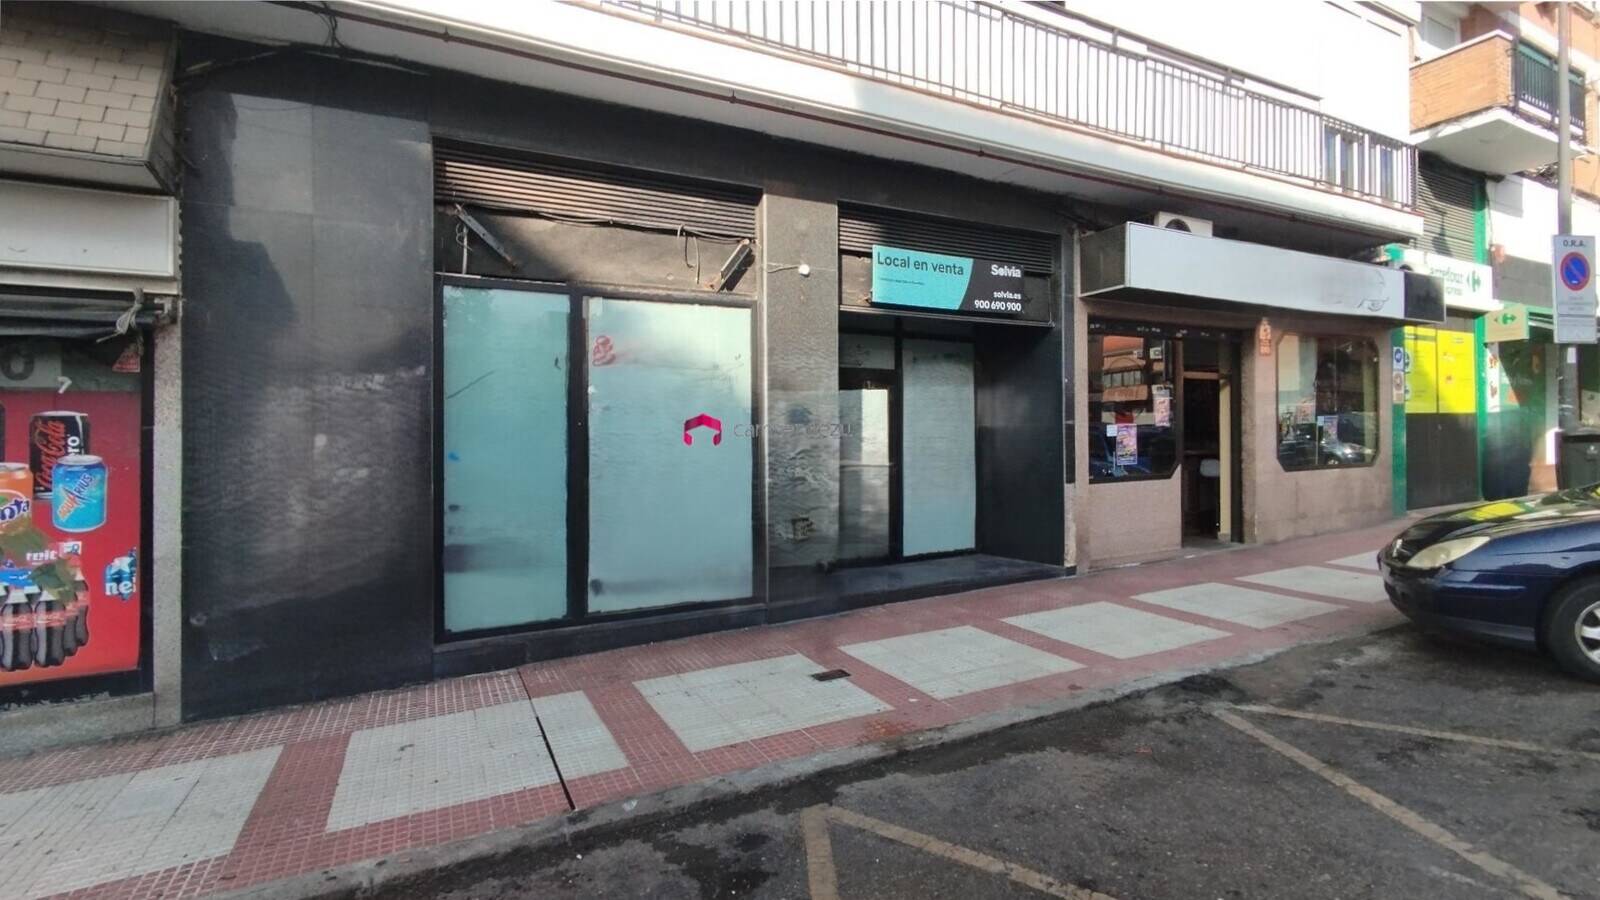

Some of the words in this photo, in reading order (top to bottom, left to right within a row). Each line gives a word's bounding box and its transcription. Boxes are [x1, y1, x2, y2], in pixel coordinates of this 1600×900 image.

[877, 251, 910, 269] Local
[913, 260, 928, 271] en
[931, 262, 964, 276] venta
[993, 290, 1022, 300] solvia.es
[974, 299, 990, 309] 900
[990, 300, 1006, 310] 690
[1006, 302, 1022, 312] 900
